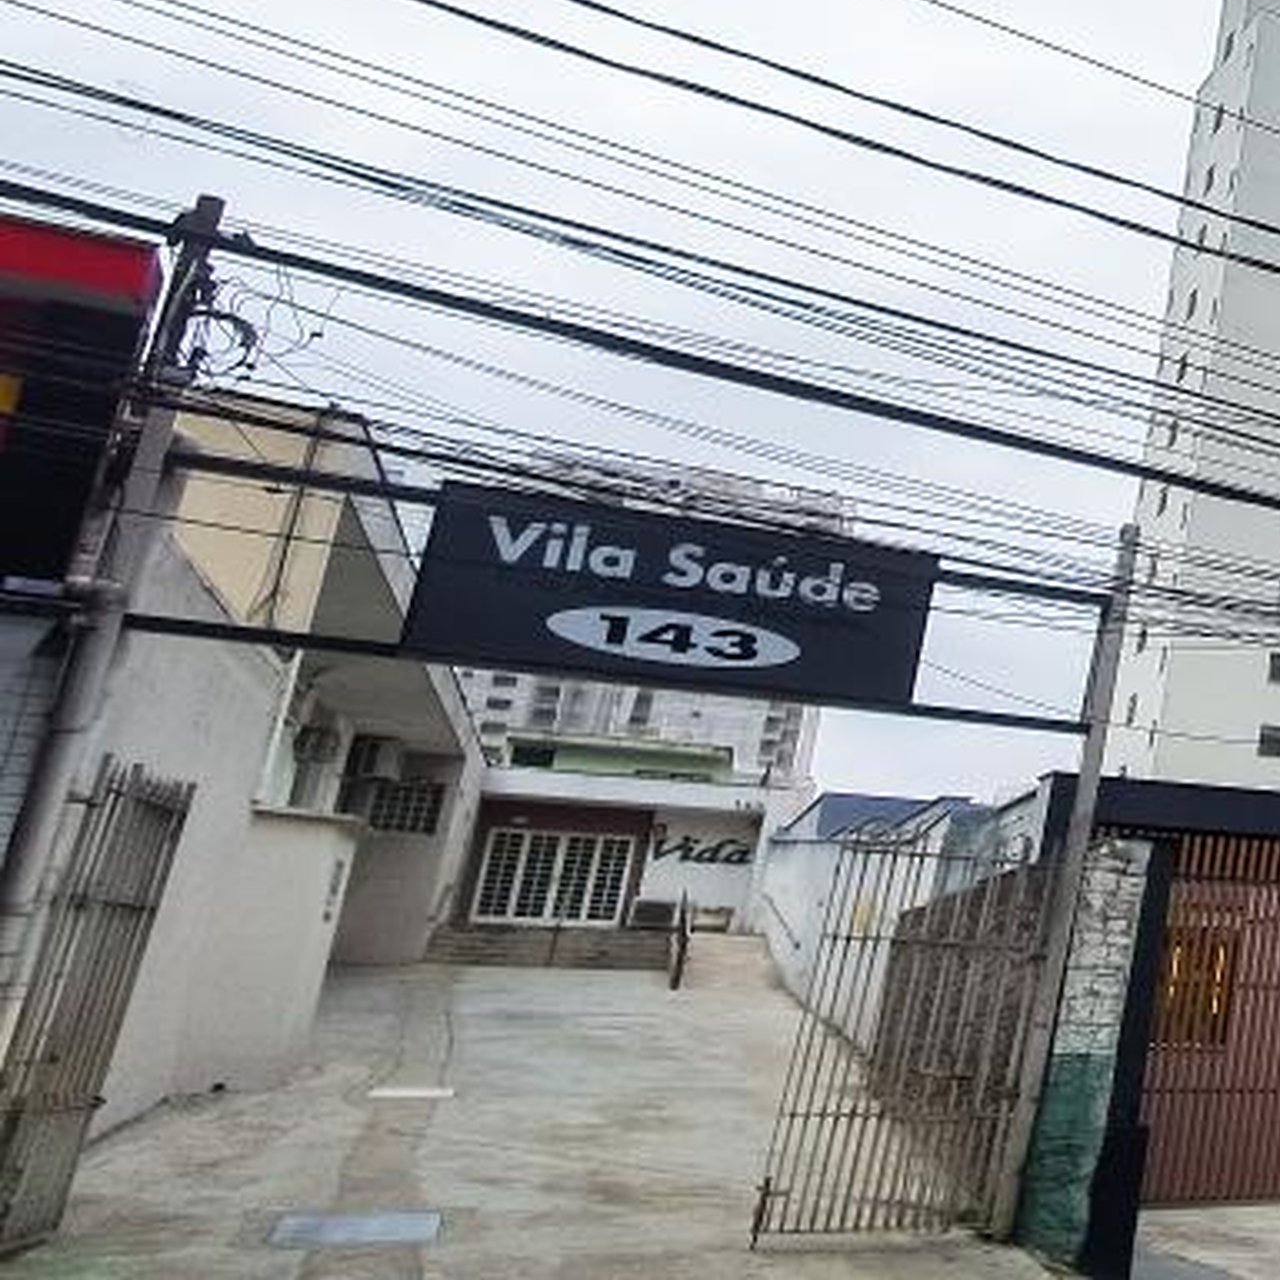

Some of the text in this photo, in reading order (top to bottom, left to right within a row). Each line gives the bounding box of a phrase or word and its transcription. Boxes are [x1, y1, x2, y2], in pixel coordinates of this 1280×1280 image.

[489, 514, 882, 613] Vila Saúde
[597, 612, 760, 662] 143
[653, 834, 751, 864] Vida
